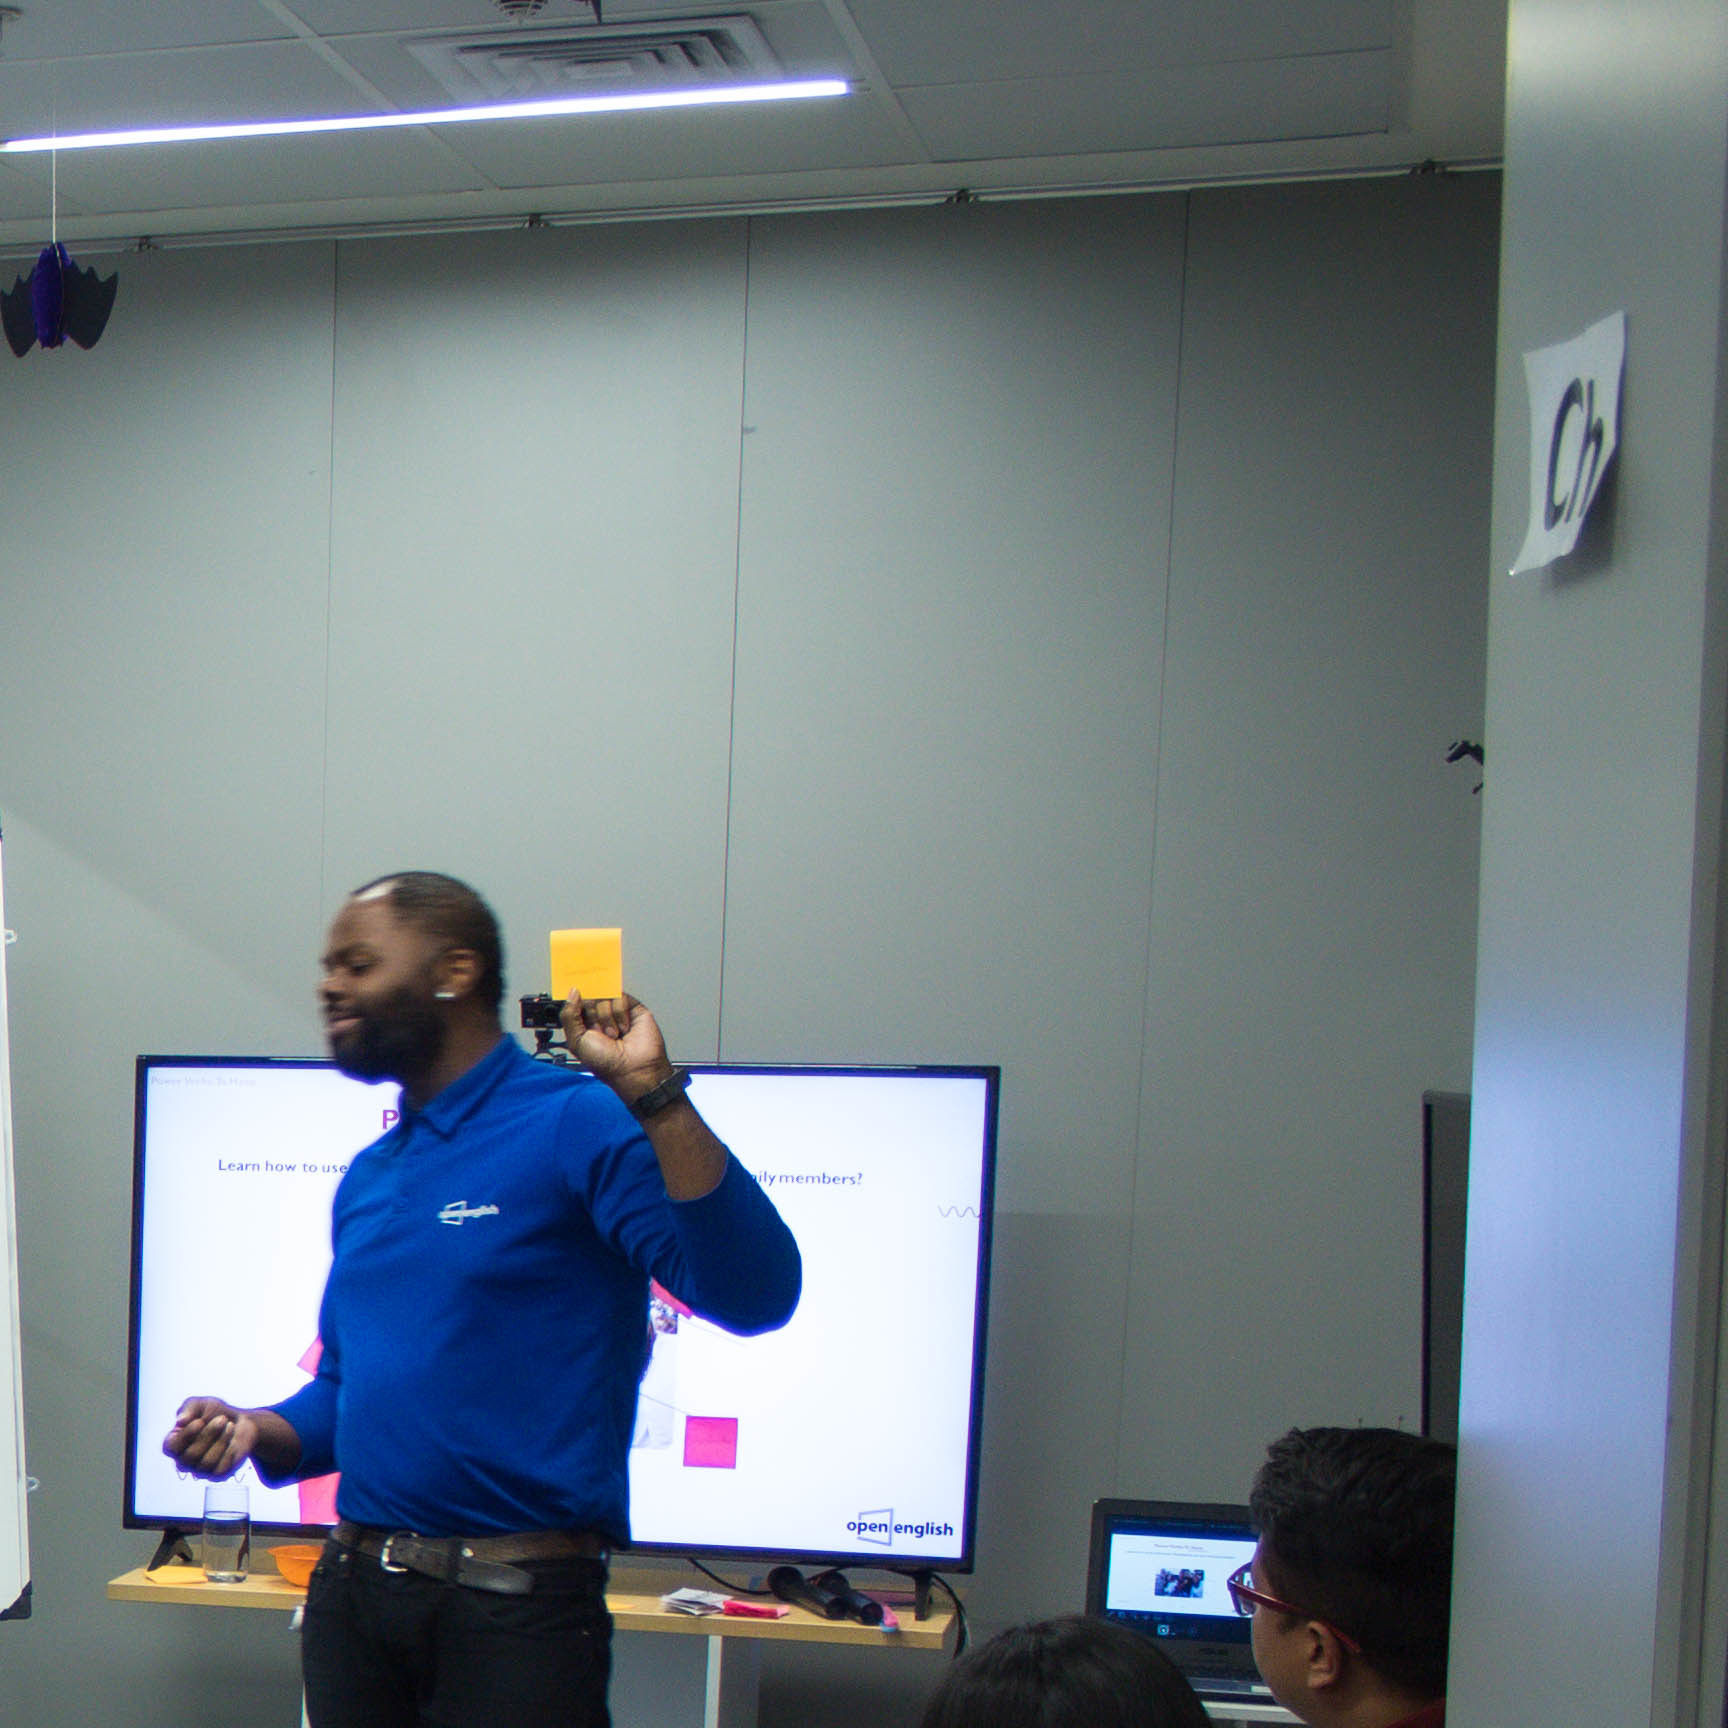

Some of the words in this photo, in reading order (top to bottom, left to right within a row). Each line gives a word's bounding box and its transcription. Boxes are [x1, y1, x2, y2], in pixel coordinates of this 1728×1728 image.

[1544, 377, 1604, 532] Ch
[382, 1109, 399, 1130] P
[218, 1159, 260, 1172] Learn
[264, 1160, 297, 1173] how
[302, 1162, 318, 1173] to
[322, 1163, 348, 1174] use
[779, 1171, 863, 1186] members?
[847, 1521, 888, 1535] open
[893, 1521, 954, 1538] english
